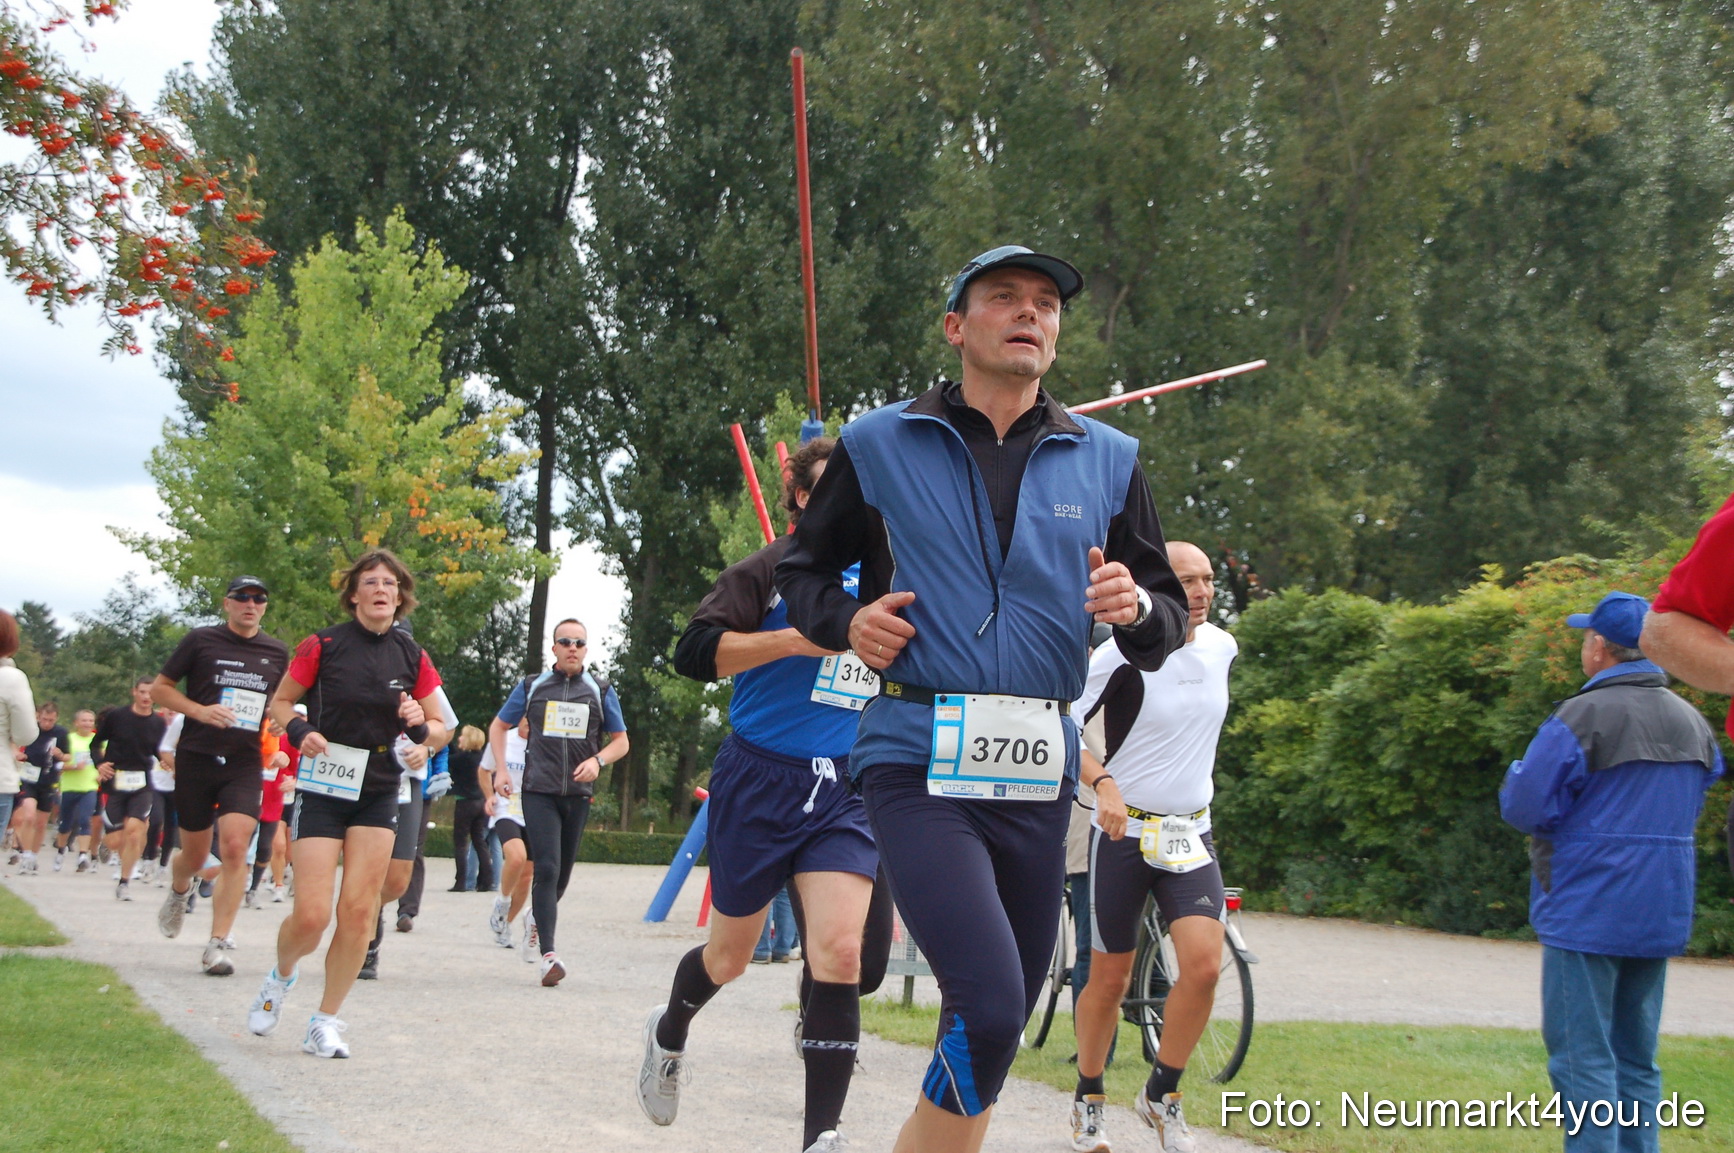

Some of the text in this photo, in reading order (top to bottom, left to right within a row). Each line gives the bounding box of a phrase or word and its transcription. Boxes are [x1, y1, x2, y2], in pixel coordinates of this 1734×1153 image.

[1053, 504, 1082, 514] GORE
[224, 669, 263, 681] Neumarkter
[841, 663, 876, 686] 3149
[235, 703, 259, 716] 3437
[562, 716, 581, 727] 132
[971, 736, 1049, 766] 3706
[318, 761, 356, 780] 3704
[1008, 783, 1057, 796] PFLEIDERER
[1166, 838, 1191, 855] 379
